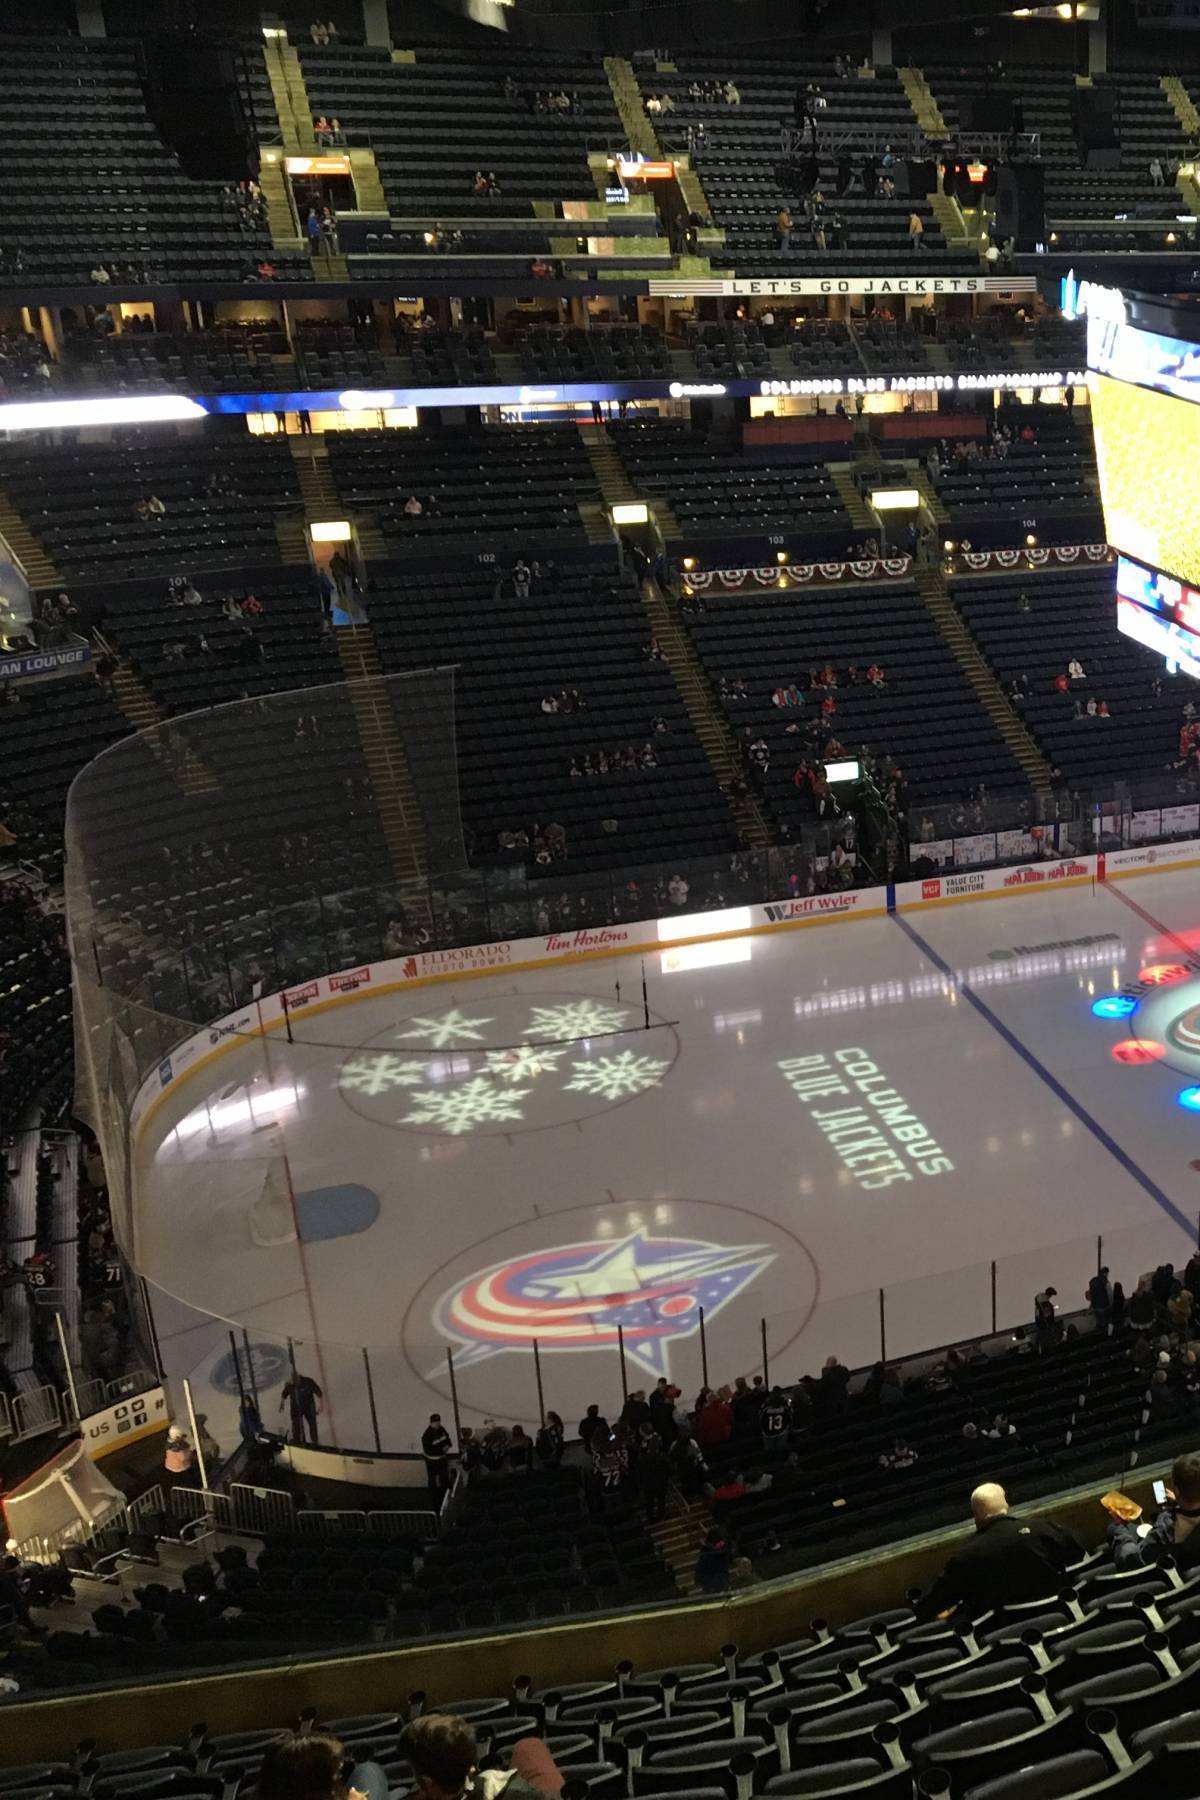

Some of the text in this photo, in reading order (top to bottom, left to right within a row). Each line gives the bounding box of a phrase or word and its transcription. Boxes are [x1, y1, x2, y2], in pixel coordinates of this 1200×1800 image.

[732, 279, 978, 294] LET'S GO JACKETS
[847, 376, 886, 393] BLUE
[890, 374, 953, 392] JACKETS
[768, 535, 785, 545] 103
[477, 553, 496, 563] 102
[26, 650, 84, 671] LOUNGE
[1113, 854, 1147, 865] VECTOR
[945, 874, 985, 888] VALUE CITY
[945, 882, 985, 896] FURNITURE
[922, 885, 940, 894] VCF
[790, 898, 816, 915] Jeff
[817, 895, 858, 909] Wyler
[543, 933, 571, 952] Tim
[572, 929, 629, 947] Hortons
[1013, 933, 1120, 956] Huntington
[421, 944, 511, 966] ELDORADO
[422, 954, 512, 975] SCIOTO DOWNS
[834, 1047, 956, 1176] COLUMBUS
[777, 1054, 914, 1190] BLUE JACKETS
[106, 1267, 120, 1281] 71
[90, 1422, 110, 1438] US
[768, 1415, 783, 1431] 13
[603, 1470, 620, 1487] 72
